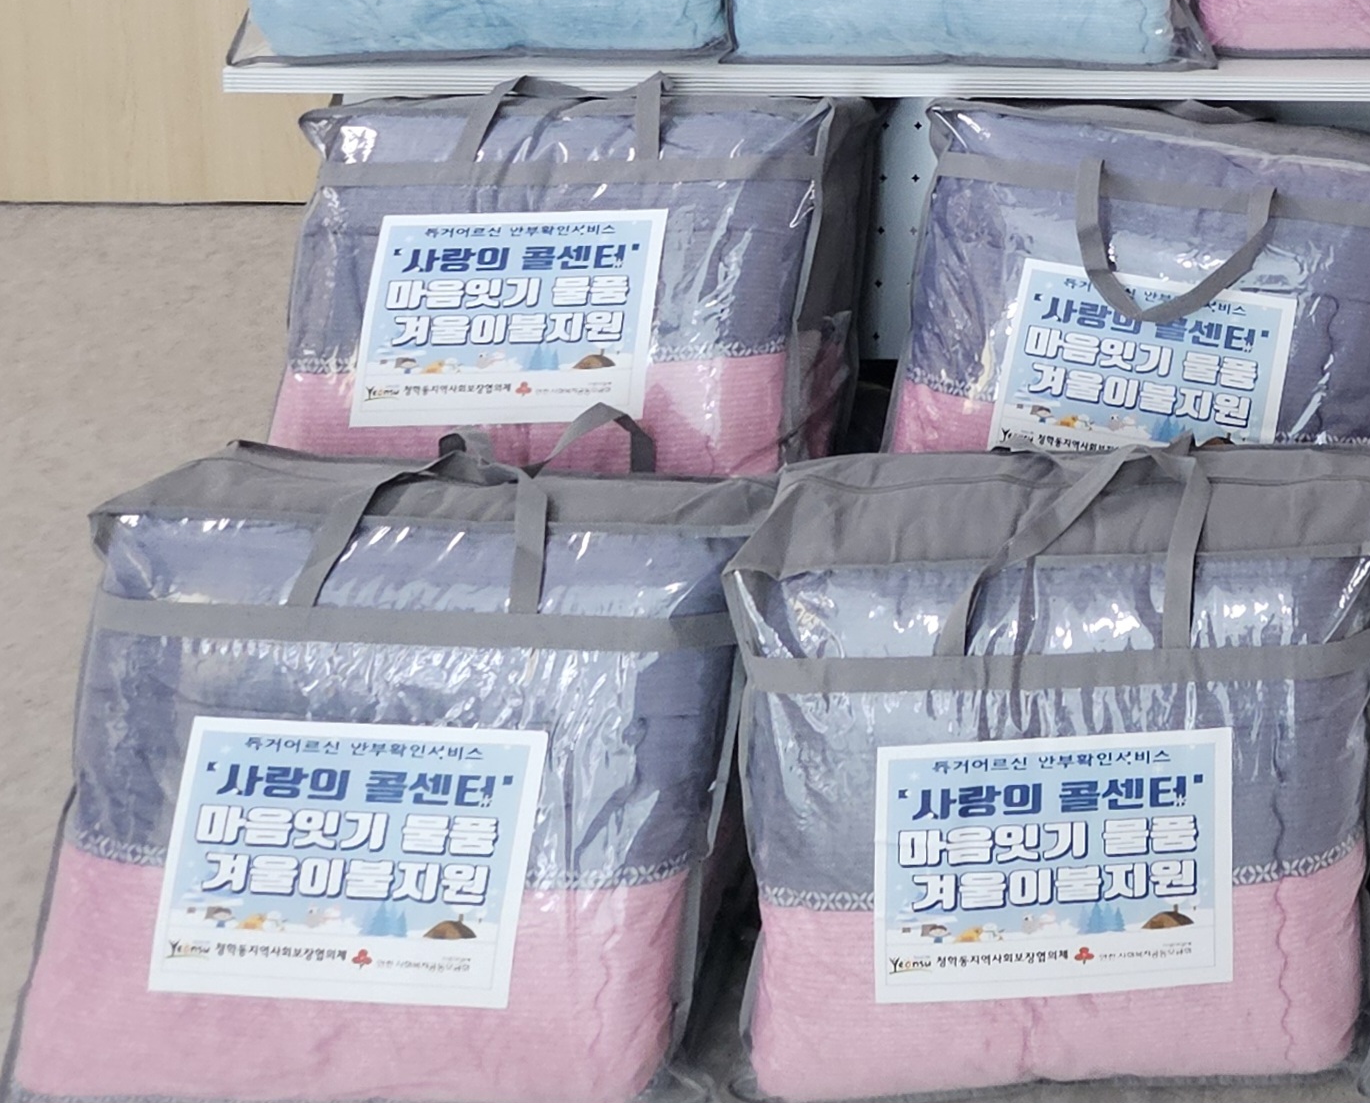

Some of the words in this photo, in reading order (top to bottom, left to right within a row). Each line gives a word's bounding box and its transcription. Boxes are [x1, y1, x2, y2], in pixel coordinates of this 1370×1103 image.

[386, 277, 541, 310] 마음잇기
[552, 275, 630, 306] 물품
[1064, 278, 1137, 301] 독거신
[392, 311, 625, 347] 겨울이불지원
[1024, 325, 1172, 377] 마음잇기
[1182, 351, 1258, 390] 물품
[1028, 363, 1250, 428] 겨울이불지원
[244, 736, 340, 754] 독거어르신
[933, 757, 1028, 774] 독거어르신
[195, 804, 388, 851] 마음잇기
[401, 813, 499, 857] 물품
[898, 821, 1088, 868] 마음잇기
[1102, 815, 1198, 857] 물품
[202, 851, 490, 905] 겨울이불지원
[912, 859, 1197, 913] 겨울이불지원
